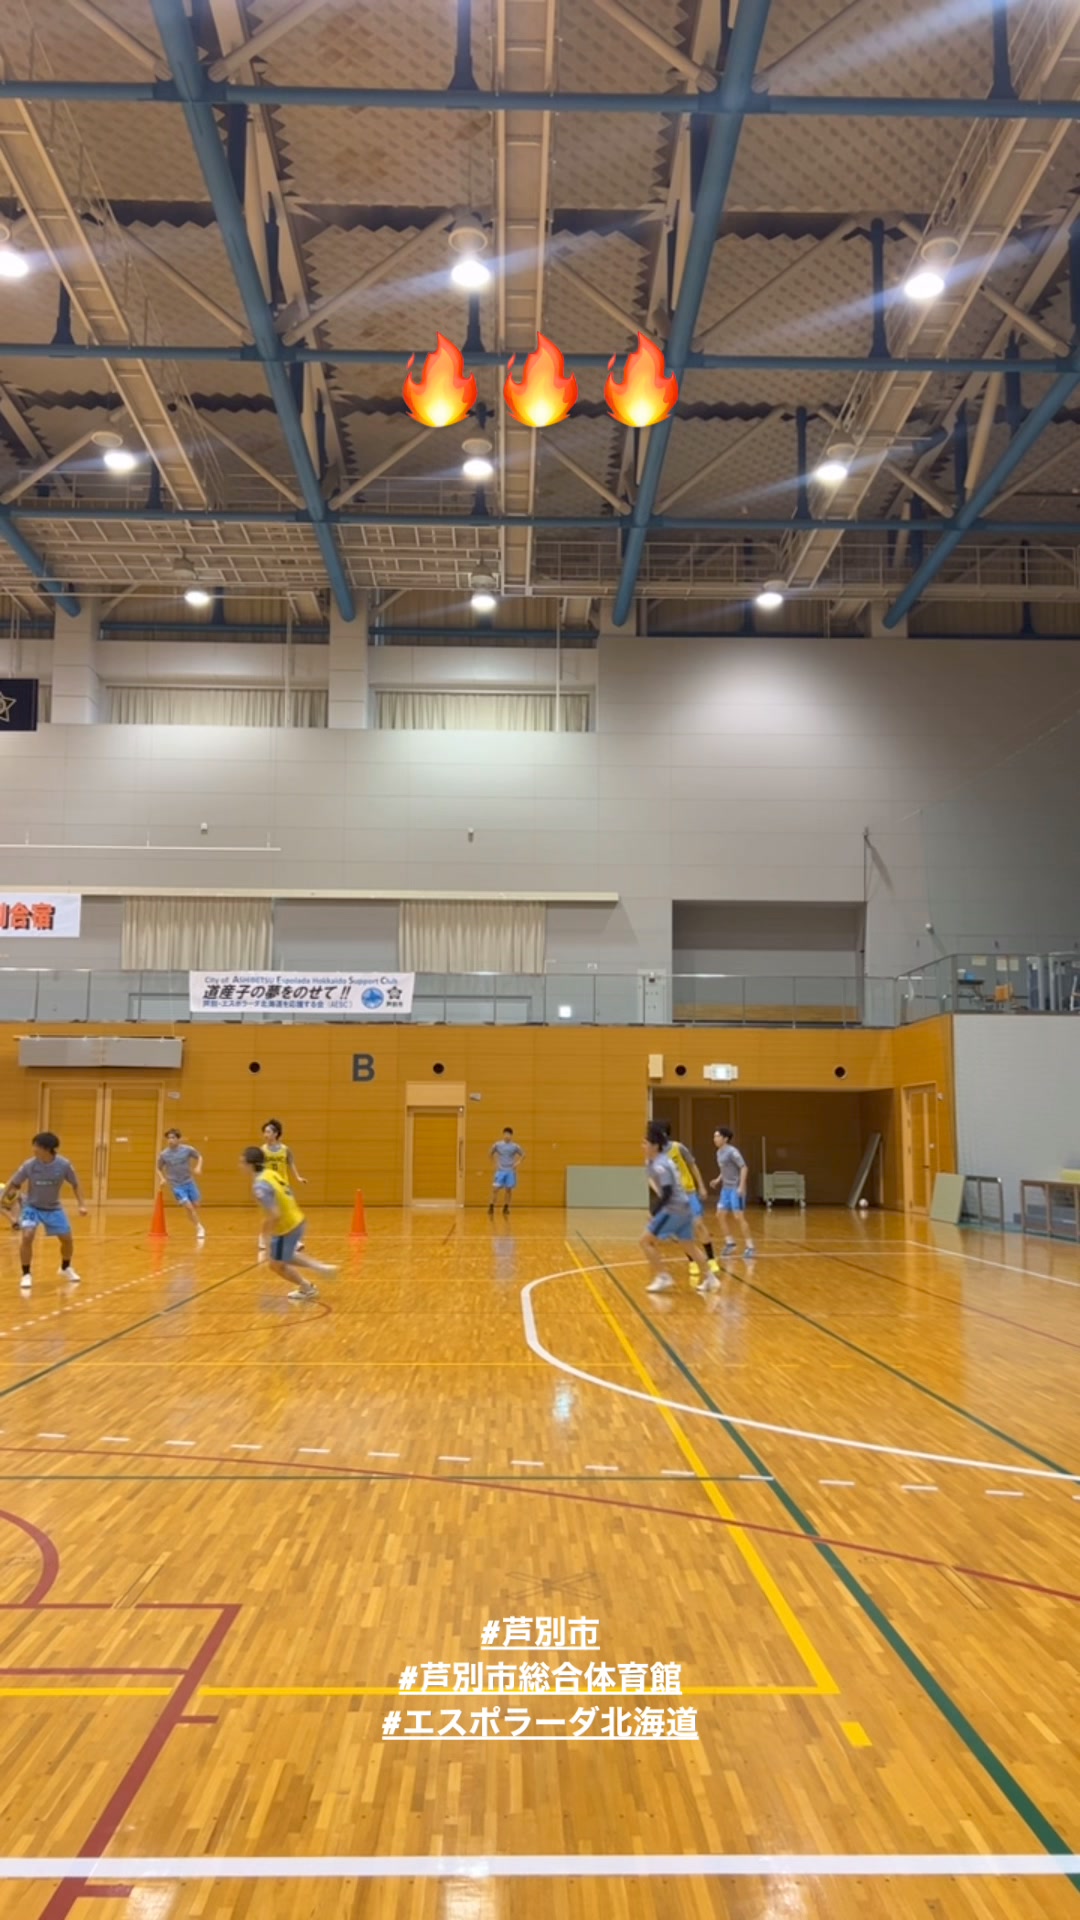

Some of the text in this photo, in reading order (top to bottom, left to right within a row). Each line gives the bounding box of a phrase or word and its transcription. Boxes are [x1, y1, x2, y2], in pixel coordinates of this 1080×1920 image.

[348, 976, 379, 986] Support
[380, 977, 398, 985] Club
[352, 1053, 375, 1082] B
